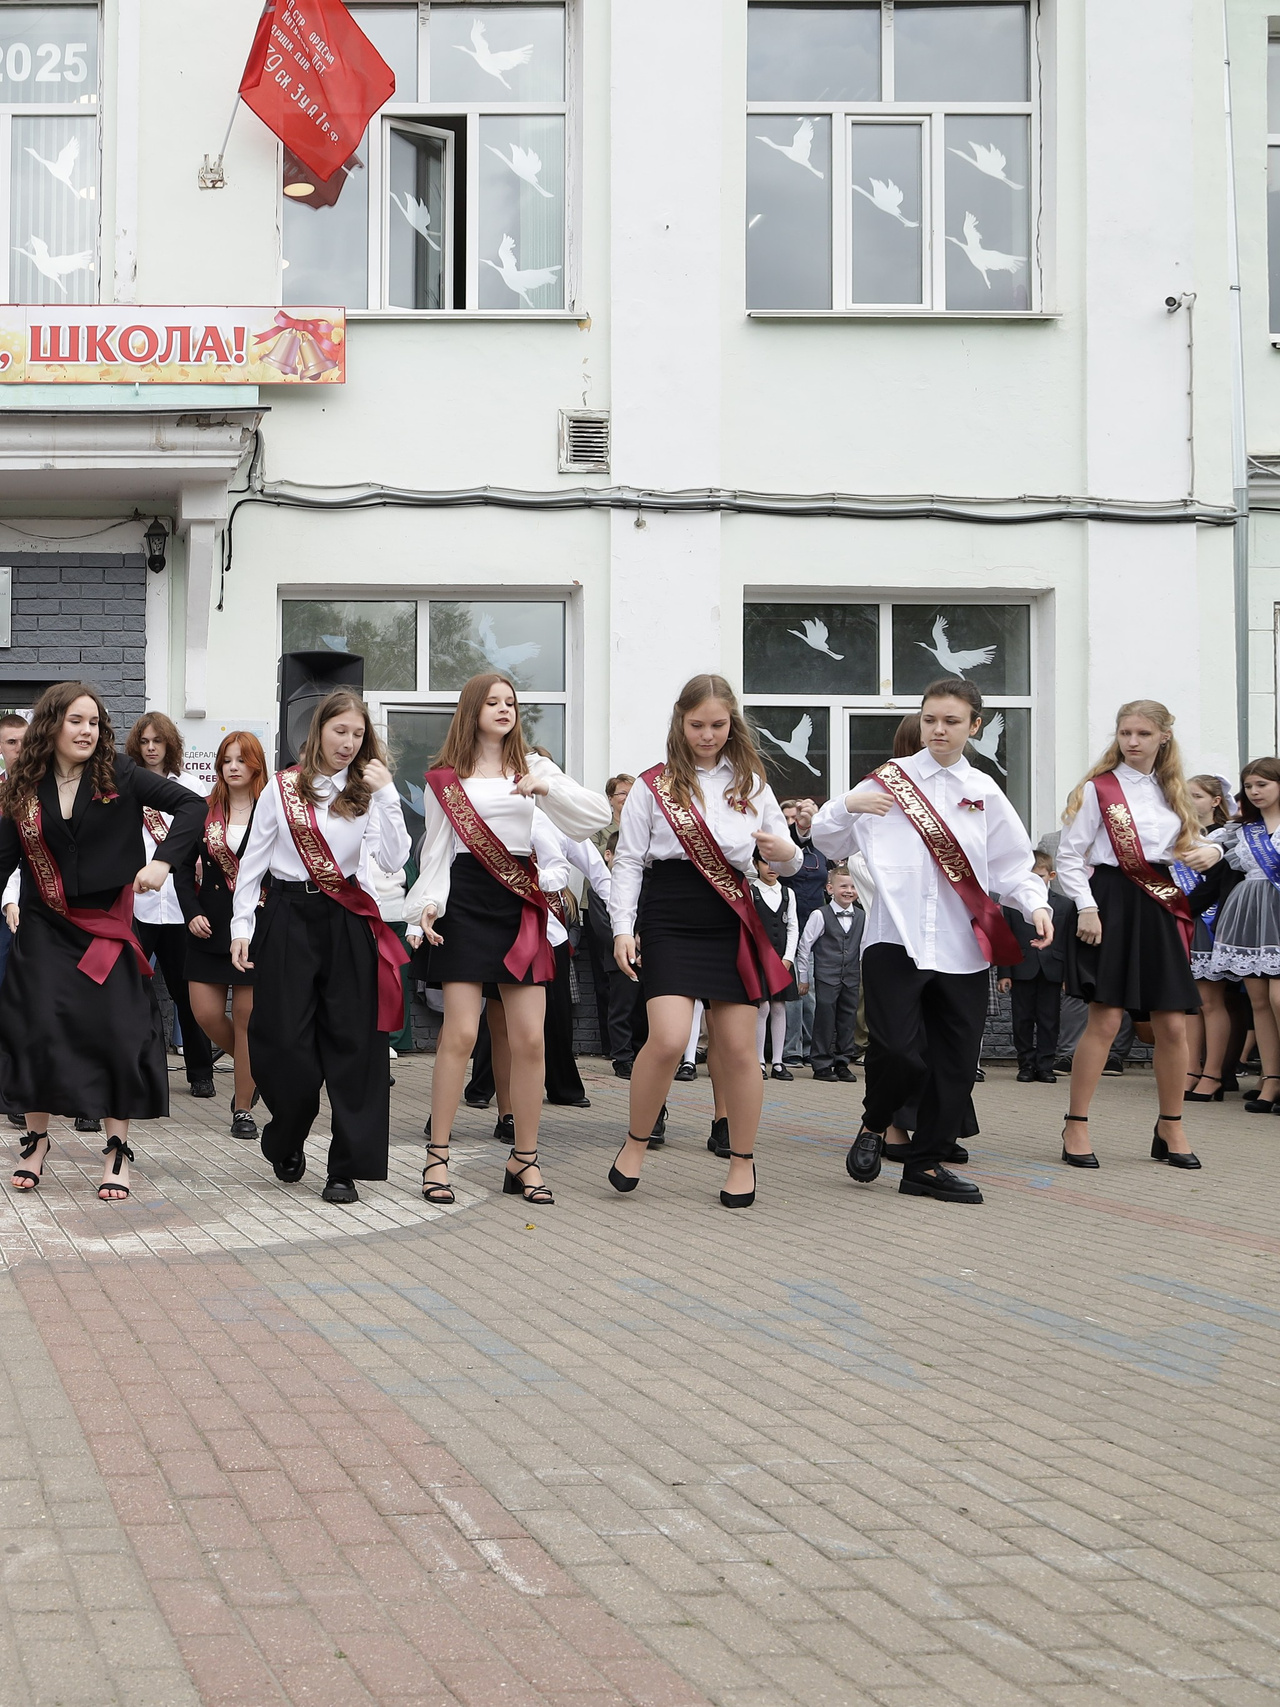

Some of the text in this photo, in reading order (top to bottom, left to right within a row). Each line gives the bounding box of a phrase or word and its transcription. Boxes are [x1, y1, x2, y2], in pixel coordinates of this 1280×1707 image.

[28, 324, 247, 364] ШКОЛА!
[453, 803, 540, 897] Выпускник 2025
[885, 777, 971, 883] Выпускник 2025
[703, 862, 744, 902] 2025
